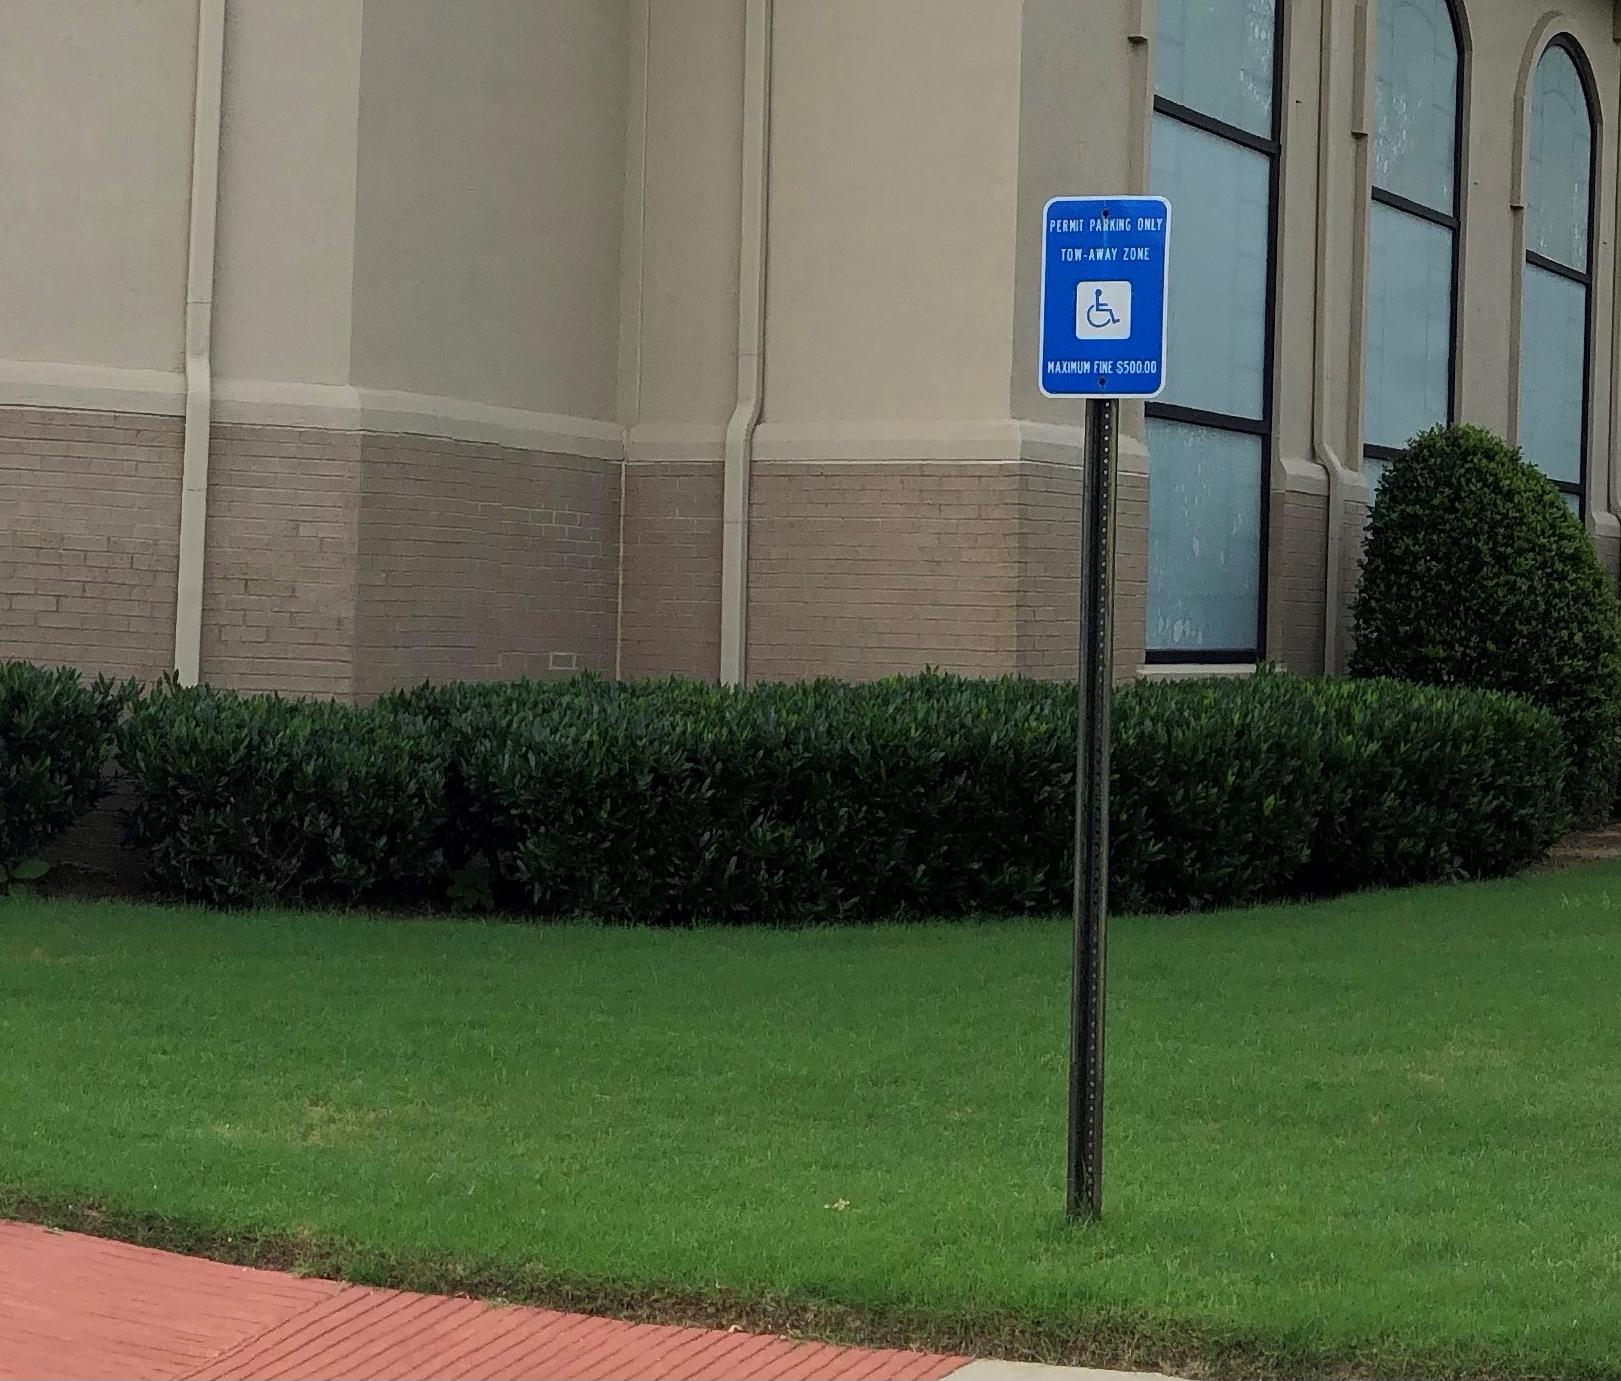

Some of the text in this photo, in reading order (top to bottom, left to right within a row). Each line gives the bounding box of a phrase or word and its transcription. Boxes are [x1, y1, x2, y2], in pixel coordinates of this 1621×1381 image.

[1049, 218, 1164, 233] PERMIT PARKING ONLY
[1061, 247, 1150, 261] TOW-AWAY ZONE
[1047, 361, 1157, 375] MAXIMUM FINE $500.00
